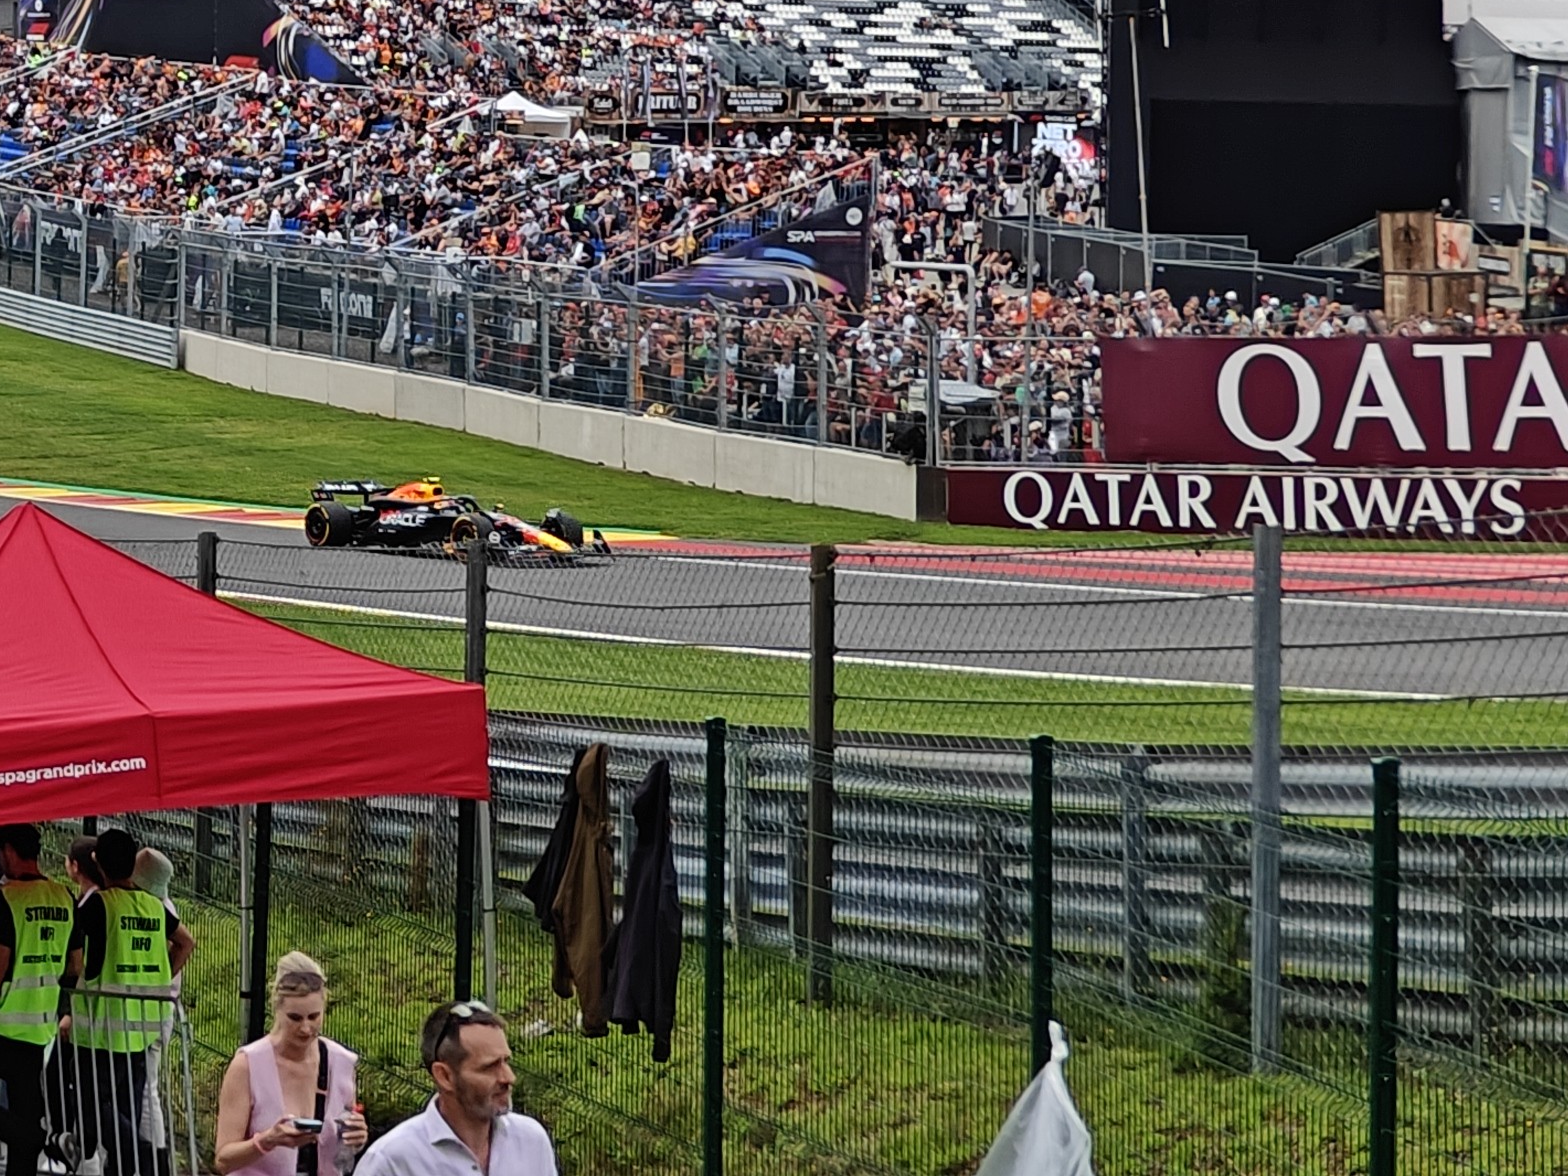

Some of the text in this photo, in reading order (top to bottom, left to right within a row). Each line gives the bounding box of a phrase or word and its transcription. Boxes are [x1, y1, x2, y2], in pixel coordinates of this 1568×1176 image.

[1037, 122, 1078, 140] NET
[786, 230, 816, 243] SPA
[1003, 470, 1527, 535] QATAR AIRWAYS
[378, 513, 427, 526] ORACLE
